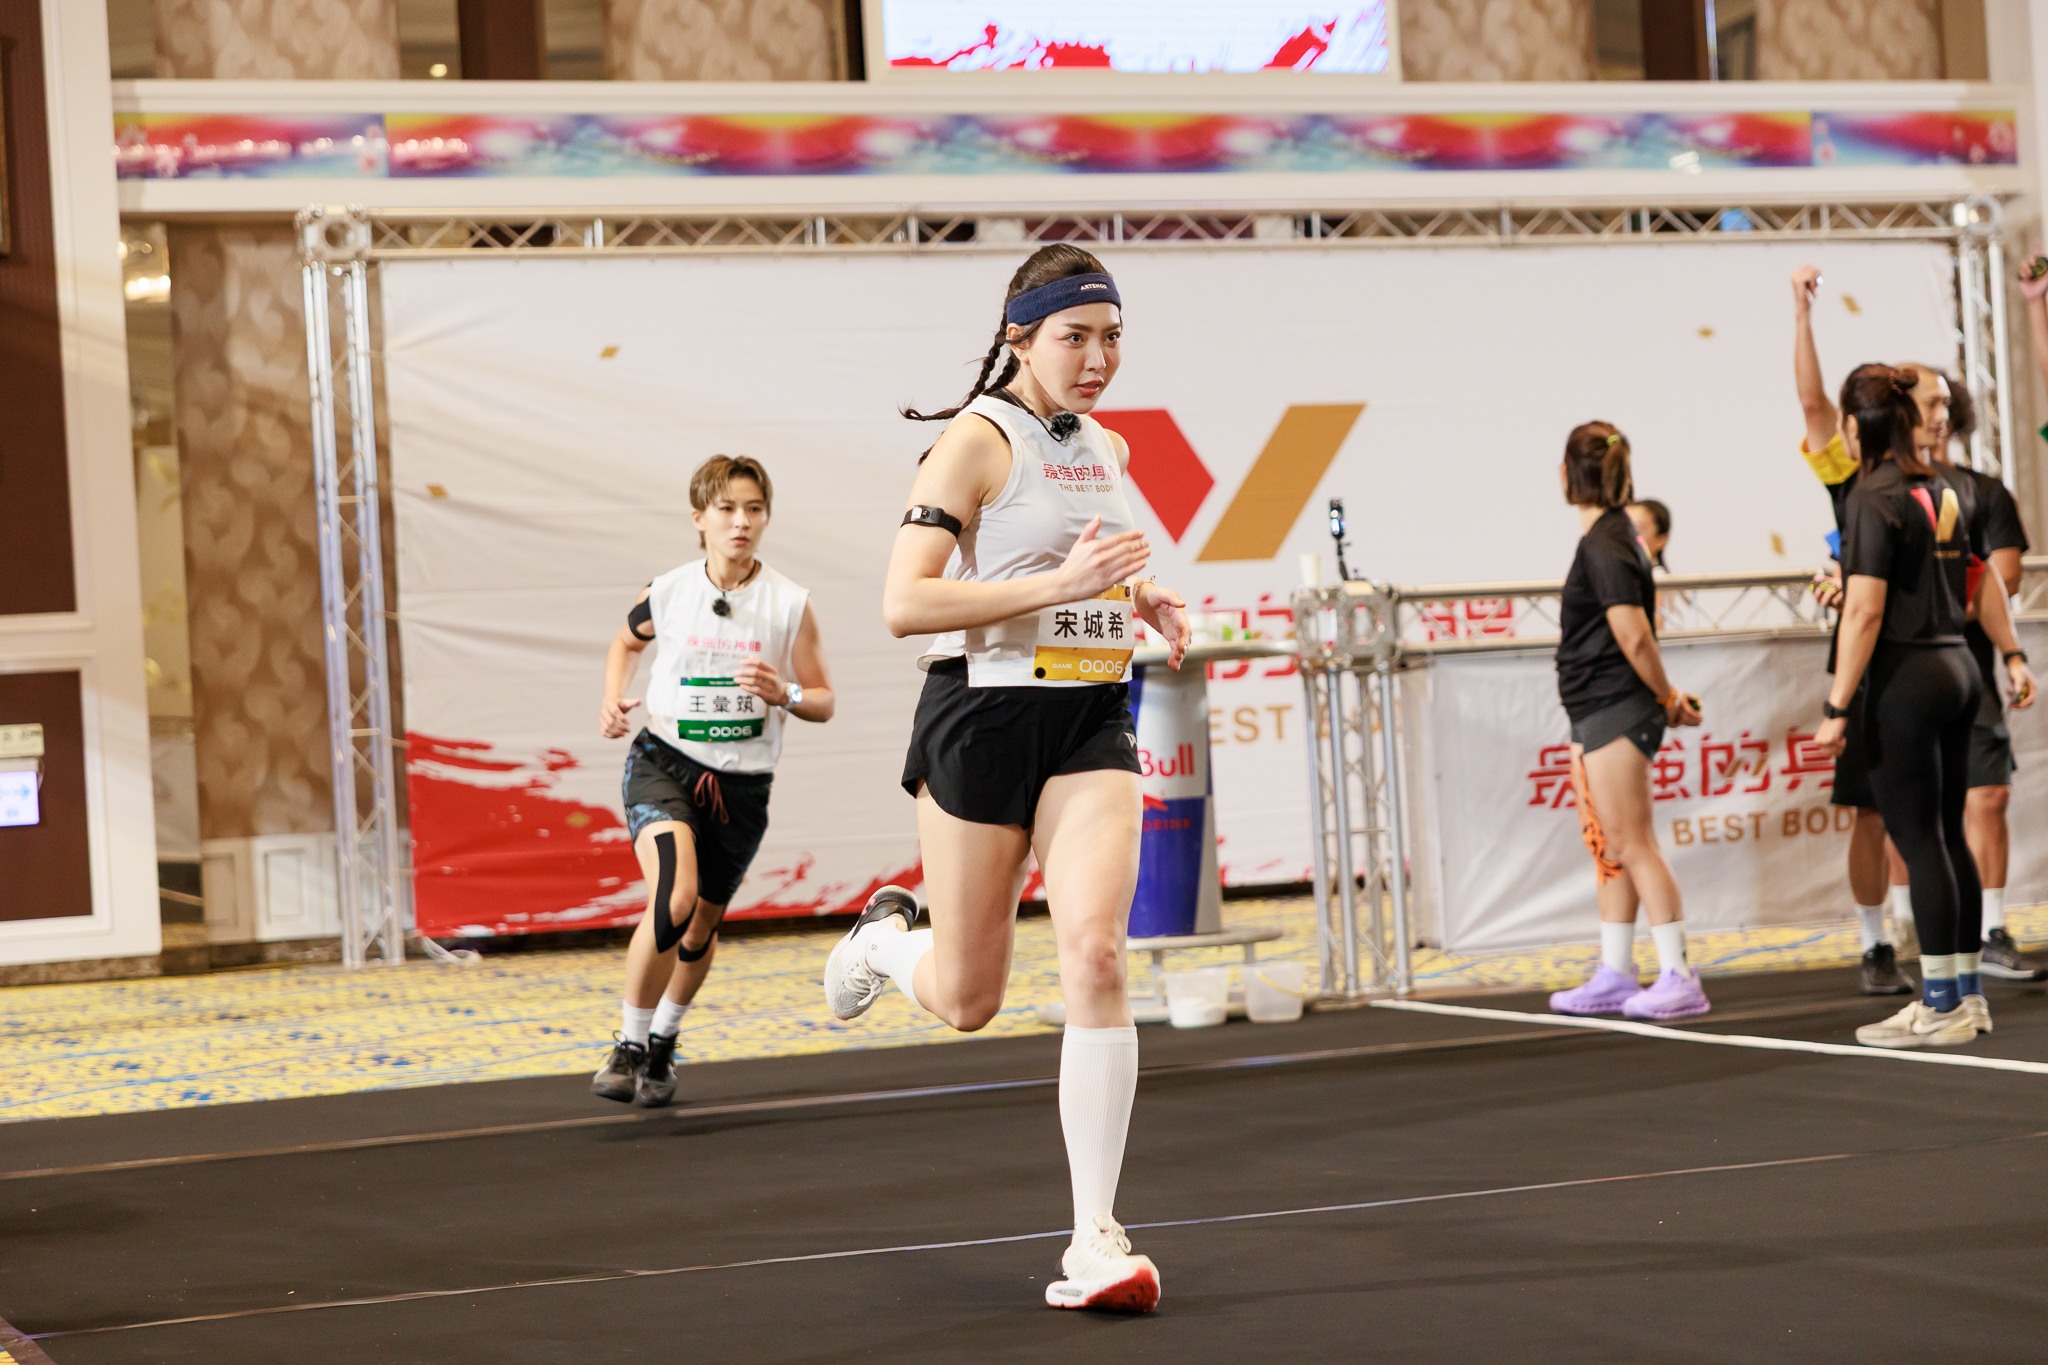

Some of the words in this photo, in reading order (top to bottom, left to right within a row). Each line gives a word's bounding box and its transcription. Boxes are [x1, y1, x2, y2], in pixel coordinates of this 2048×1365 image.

[1080, 283, 1108, 291] ARTENGO
[1059, 484, 1074, 492] THE
[1076, 484, 1093, 493] BEST
[1095, 484, 1114, 493] BODY
[1054, 609, 1124, 640] 宋城希
[1079, 659, 1124, 674] 0006
[1209, 703, 1293, 744] EST
[1137, 743, 1195, 778] Bull
[1526, 726, 1837, 809] 最強的身
[1671, 812, 1768, 845] BEST
[1781, 805, 1856, 837] BOD
